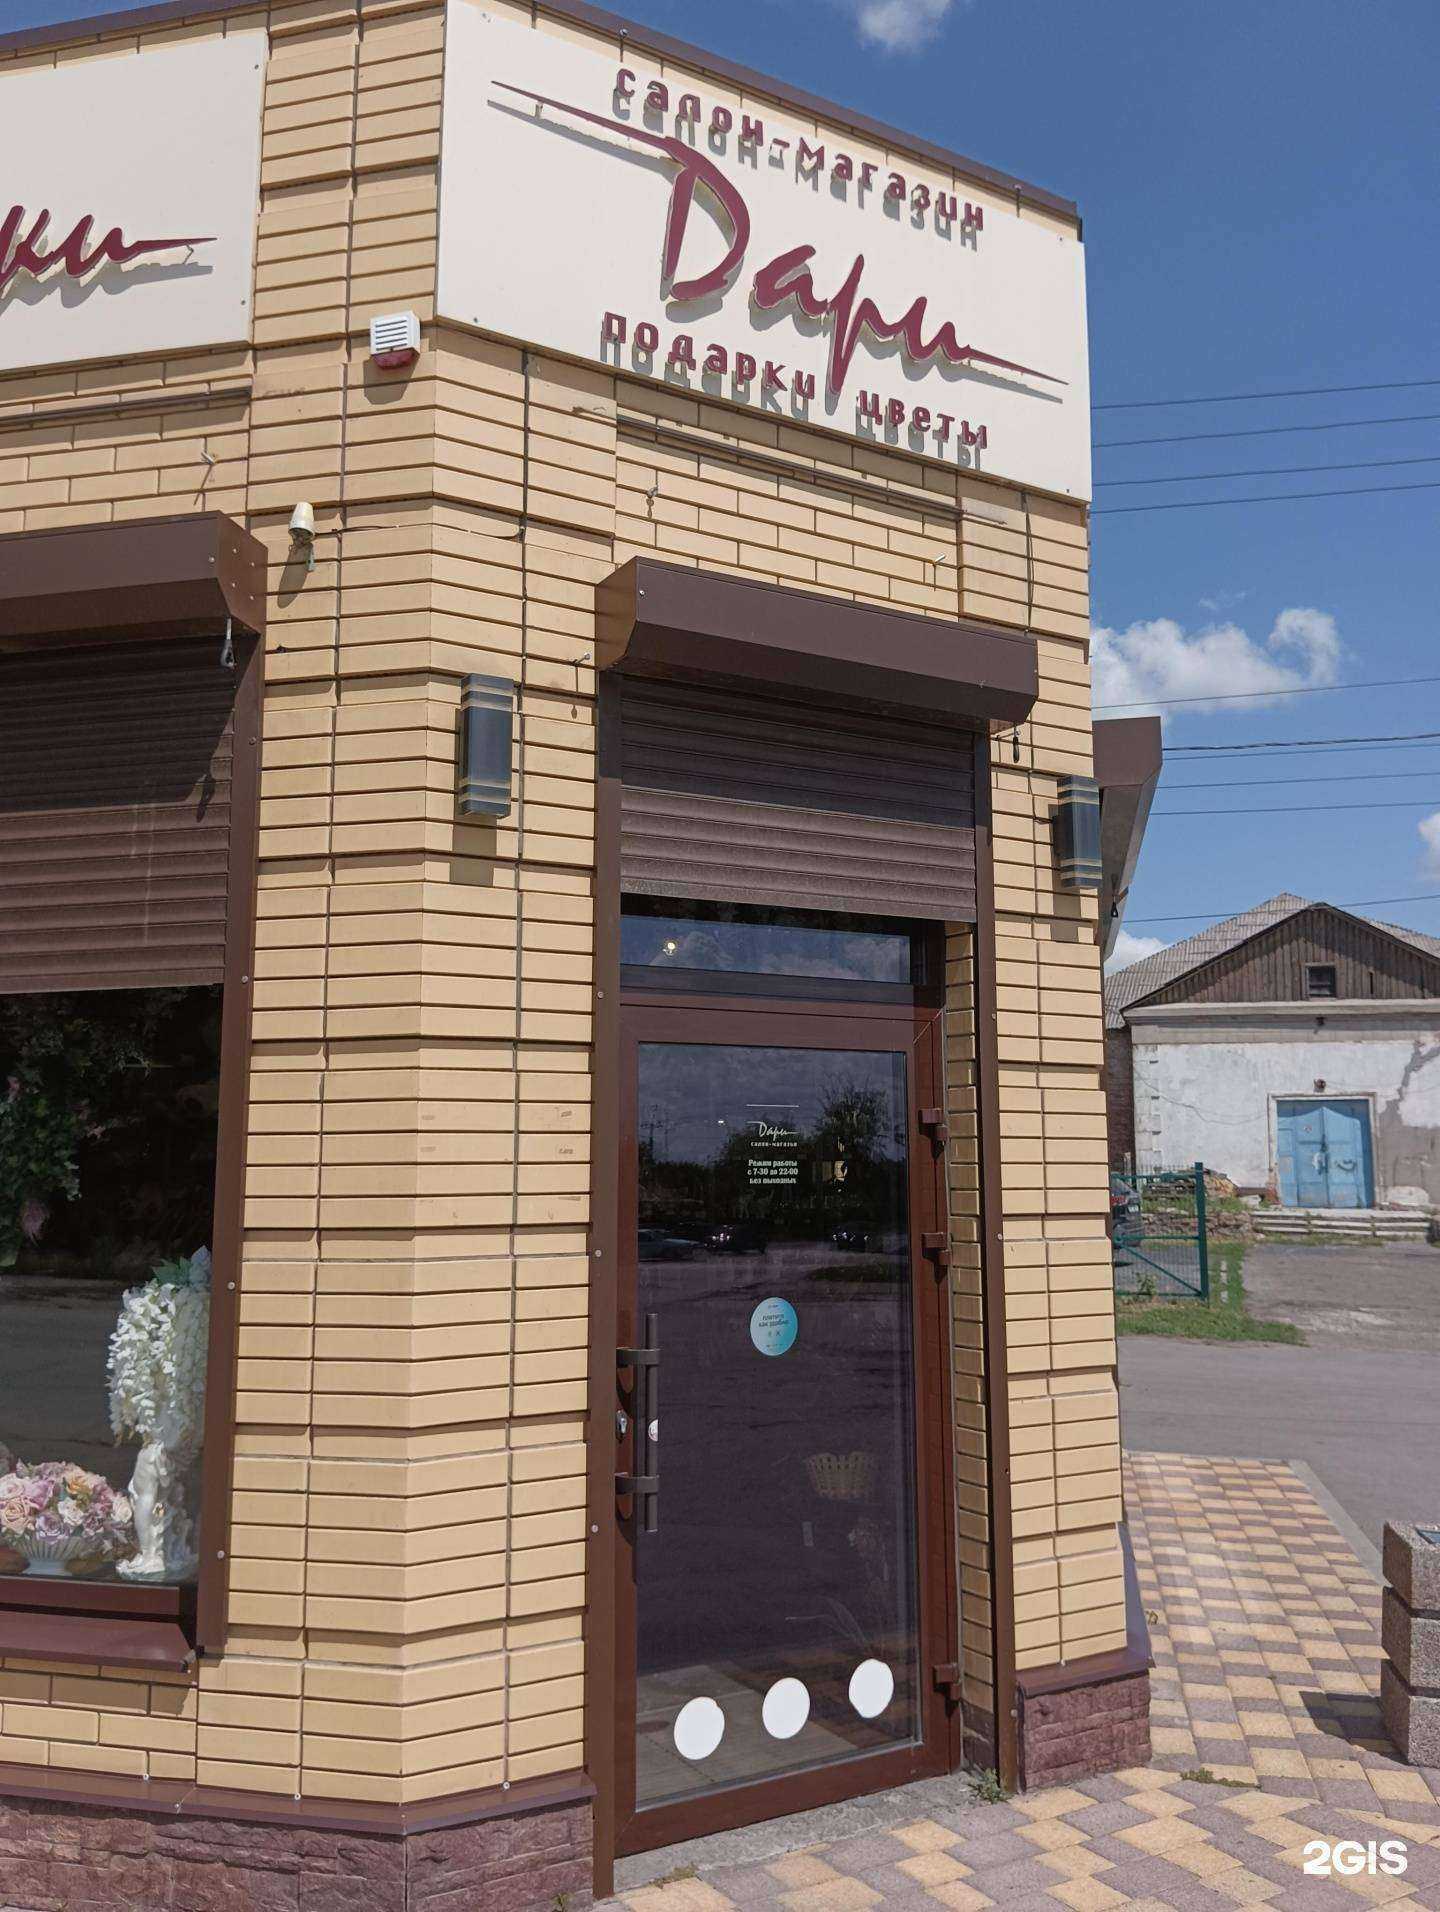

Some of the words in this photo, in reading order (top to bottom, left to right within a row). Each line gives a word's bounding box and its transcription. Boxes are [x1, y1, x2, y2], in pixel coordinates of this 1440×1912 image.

[615, 67, 984, 231] салон-магазин
[490, 80, 1069, 396] Дари
[604, 311, 816, 401] подарки
[859, 389, 988, 450] цветы
[746, 1120, 800, 1141] Дари
[748, 1159, 772, 1167] Режим
[773, 1159, 798, 1168] работы
